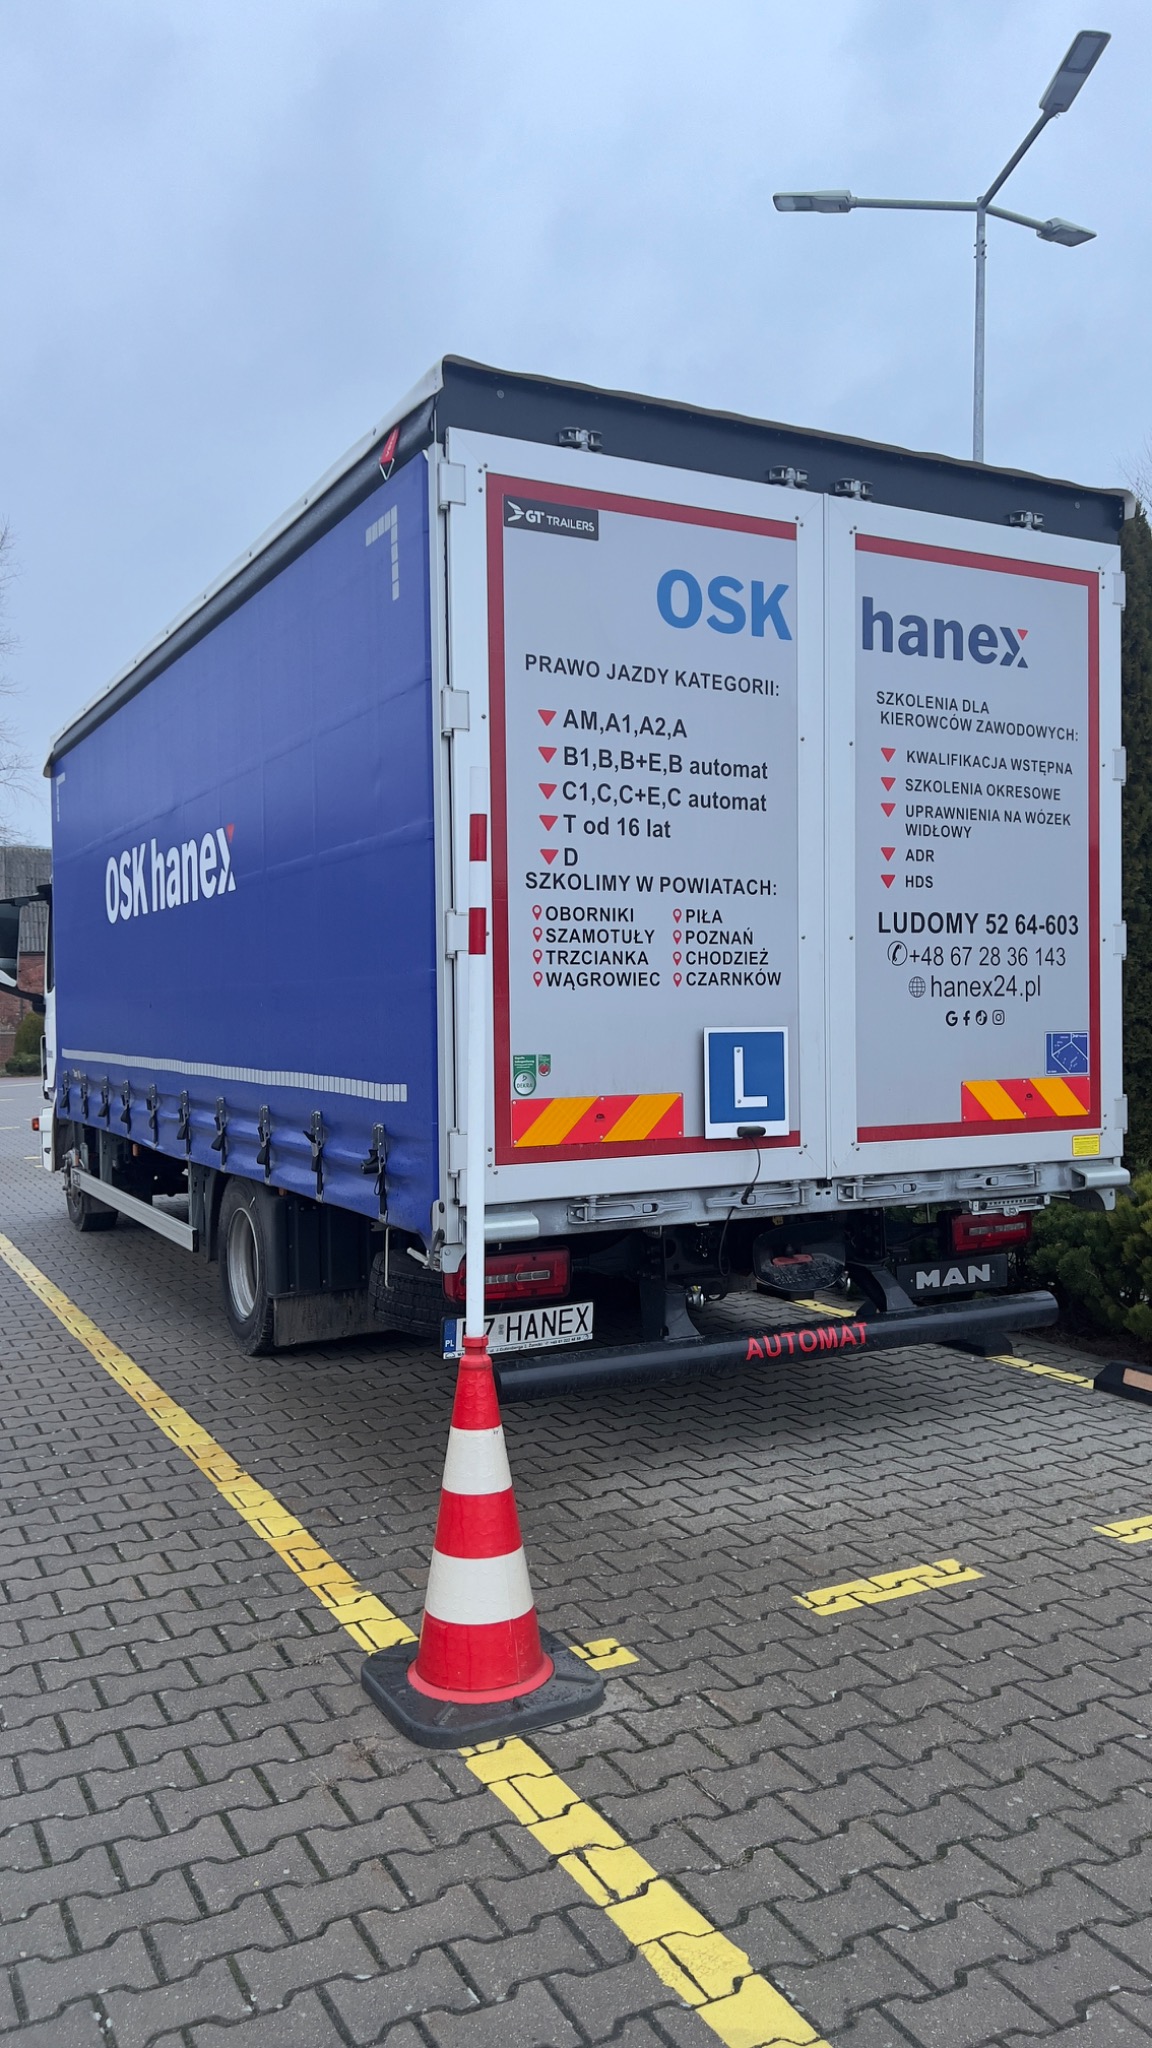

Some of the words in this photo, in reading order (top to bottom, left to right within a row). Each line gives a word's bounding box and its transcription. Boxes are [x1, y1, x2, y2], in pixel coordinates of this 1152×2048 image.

[526, 510, 545, 524] GT
[547, 516, 595, 532] TRAILERS
[657, 569, 792, 640] OSK
[862, 596, 1028, 668] hanex
[525, 654, 600, 678] PRAWO
[606, 663, 669, 684] JAZDY
[675, 670, 780, 696] KATEGORII:
[876, 691, 958, 712] SZKOLENIA
[962, 699, 989, 714] DLA
[563, 709, 687, 740] AM,A1,A2,A
[880, 711, 972, 732] KIEROWCÓW
[976, 720, 1078, 742] ZAWODOWYCH:
[564, 747, 682, 776] B1,B,B+E,B
[690, 758, 768, 779] automat
[906, 751, 1007, 770] KWALIFIKACJA
[1011, 758, 1073, 776] WSTĘPNA
[562, 781, 681, 808] C1,C,C+E,C
[688, 790, 767, 812] automat
[905, 779, 983, 796] SZKOLENIA
[986, 784, 1061, 801] OKRESOWE
[563, 815, 576, 833] T
[583, 817, 609, 835] od
[617, 818, 640, 836] 16
[647, 819, 671, 838] lat
[905, 804, 1000, 822] UPRAWNIENIA
[1004, 810, 1022, 823] NA
[1025, 808, 1071, 826] WÓZEK
[905, 824, 972, 839] WIDŁOWY
[564, 847, 578, 866] D
[905, 849, 934, 863] ADR
[106, 842, 148, 924] OSK
[151, 824, 236, 912] hanex
[525, 872, 630, 891] SZKOLIMY
[636, 876, 654, 892] W
[660, 876, 777, 896] POWIATACH:
[905, 875, 934, 889] HDS
[546, 906, 634, 922] OBORNIKI
[686, 909, 723, 923] PIŁA
[878, 912, 979, 934] LUDOMY
[986, 914, 1008, 935] 52
[1015, 914, 1079, 935] 64-603
[546, 928, 655, 943] SZAMOTUŁY
[685, 928, 753, 944] POZNAŃ
[546, 950, 648, 965] TRZCIANKA
[686, 948, 769, 965] CHODZIEŻ
[909, 946, 944, 966] +48
[950, 946, 972, 966] 67
[979, 947, 1000, 966] 28
[1007, 947, 1028, 966] 36
[1036, 947, 1066, 966] 143
[546, 972, 660, 990] WĄGROWIEC
[686, 969, 782, 986] CZARNKÓW
[930, 975, 1041, 1002] hanex24.pl
[734, 1046, 768, 1108] L
[916, 1264, 991, 1290] MAN
[462, 1318, 495, 1347] 7
[506, 1306, 589, 1342] HANEX
[445, 1339, 454, 1347] PL
[746, 1322, 868, 1361] AUTOMAT
